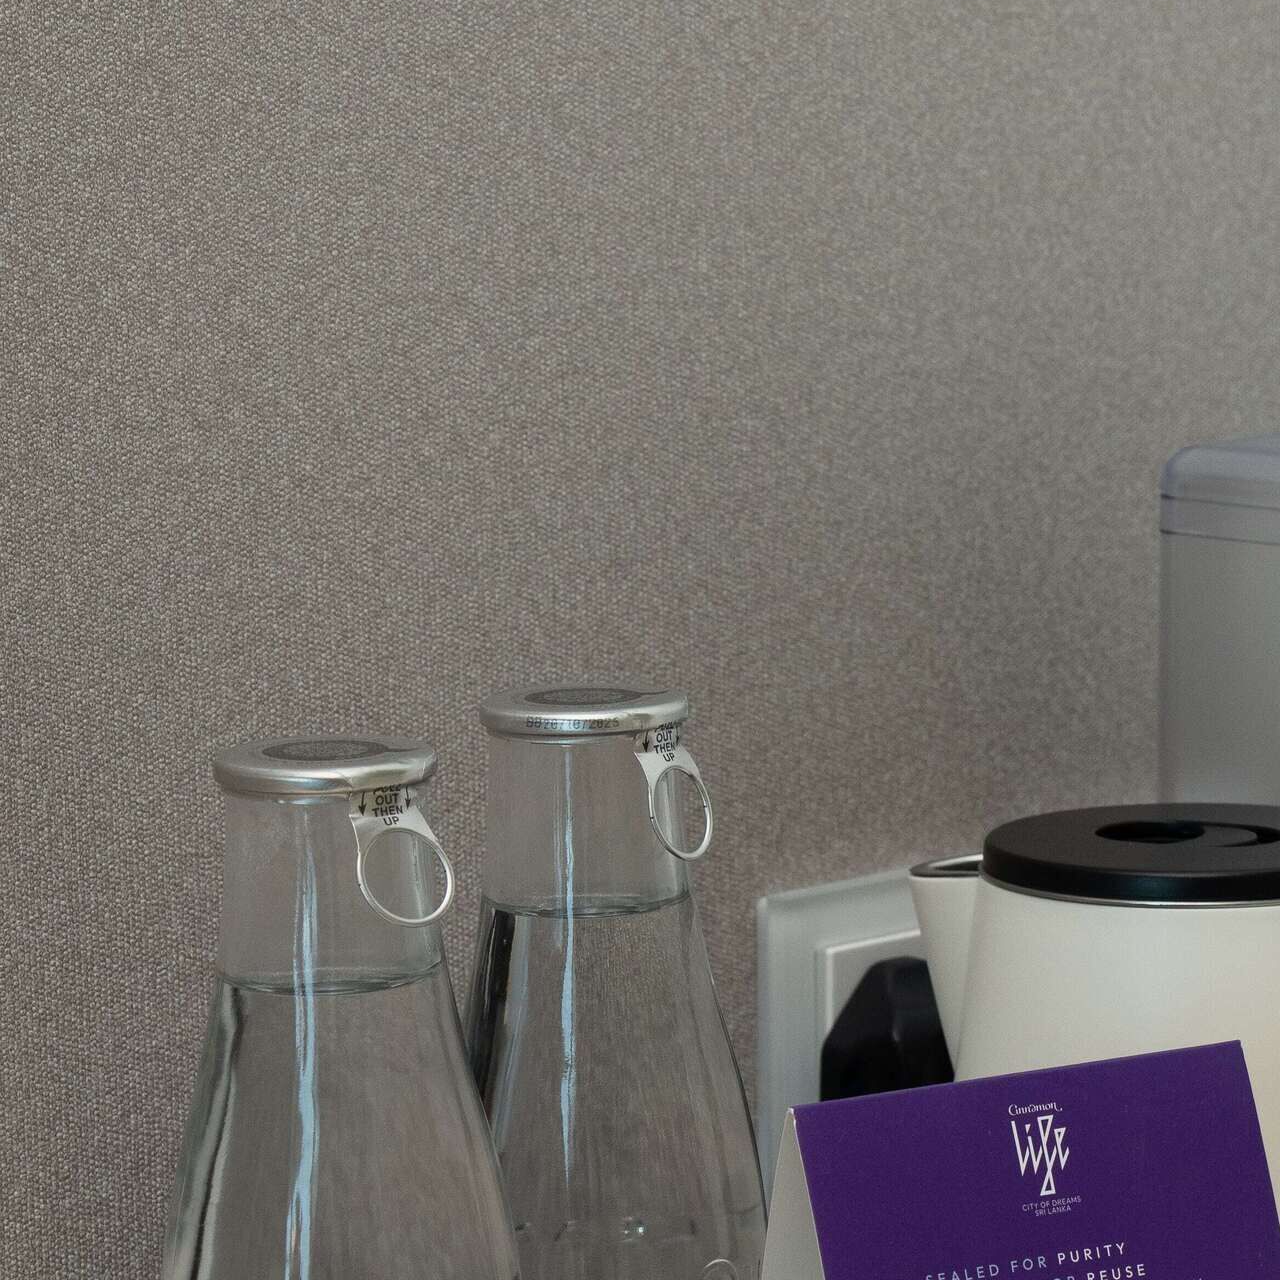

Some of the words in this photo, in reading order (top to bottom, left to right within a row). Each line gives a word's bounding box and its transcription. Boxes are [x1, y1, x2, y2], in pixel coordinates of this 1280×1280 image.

[656, 730, 673, 744] OUT
[653, 742, 676, 755] THEN
[662, 752, 675, 762] UP
[375, 792, 400, 806] OUT
[371, 804, 404, 818] THEN
[383, 815, 400, 826] UP
[1008, 1102, 1063, 1116] Cinnamon
[1021, 1202, 1039, 1212] CITY
[1040, 1200, 1051, 1209] OF
[1051, 1195, 1082, 1207] DREAMS
[1034, 1208, 1047, 1217] SRI
[1047, 1204, 1072, 1216] LANKA
[1010, 1255, 1047, 1273] FOR
[1057, 1242, 1126, 1265] PURITY
